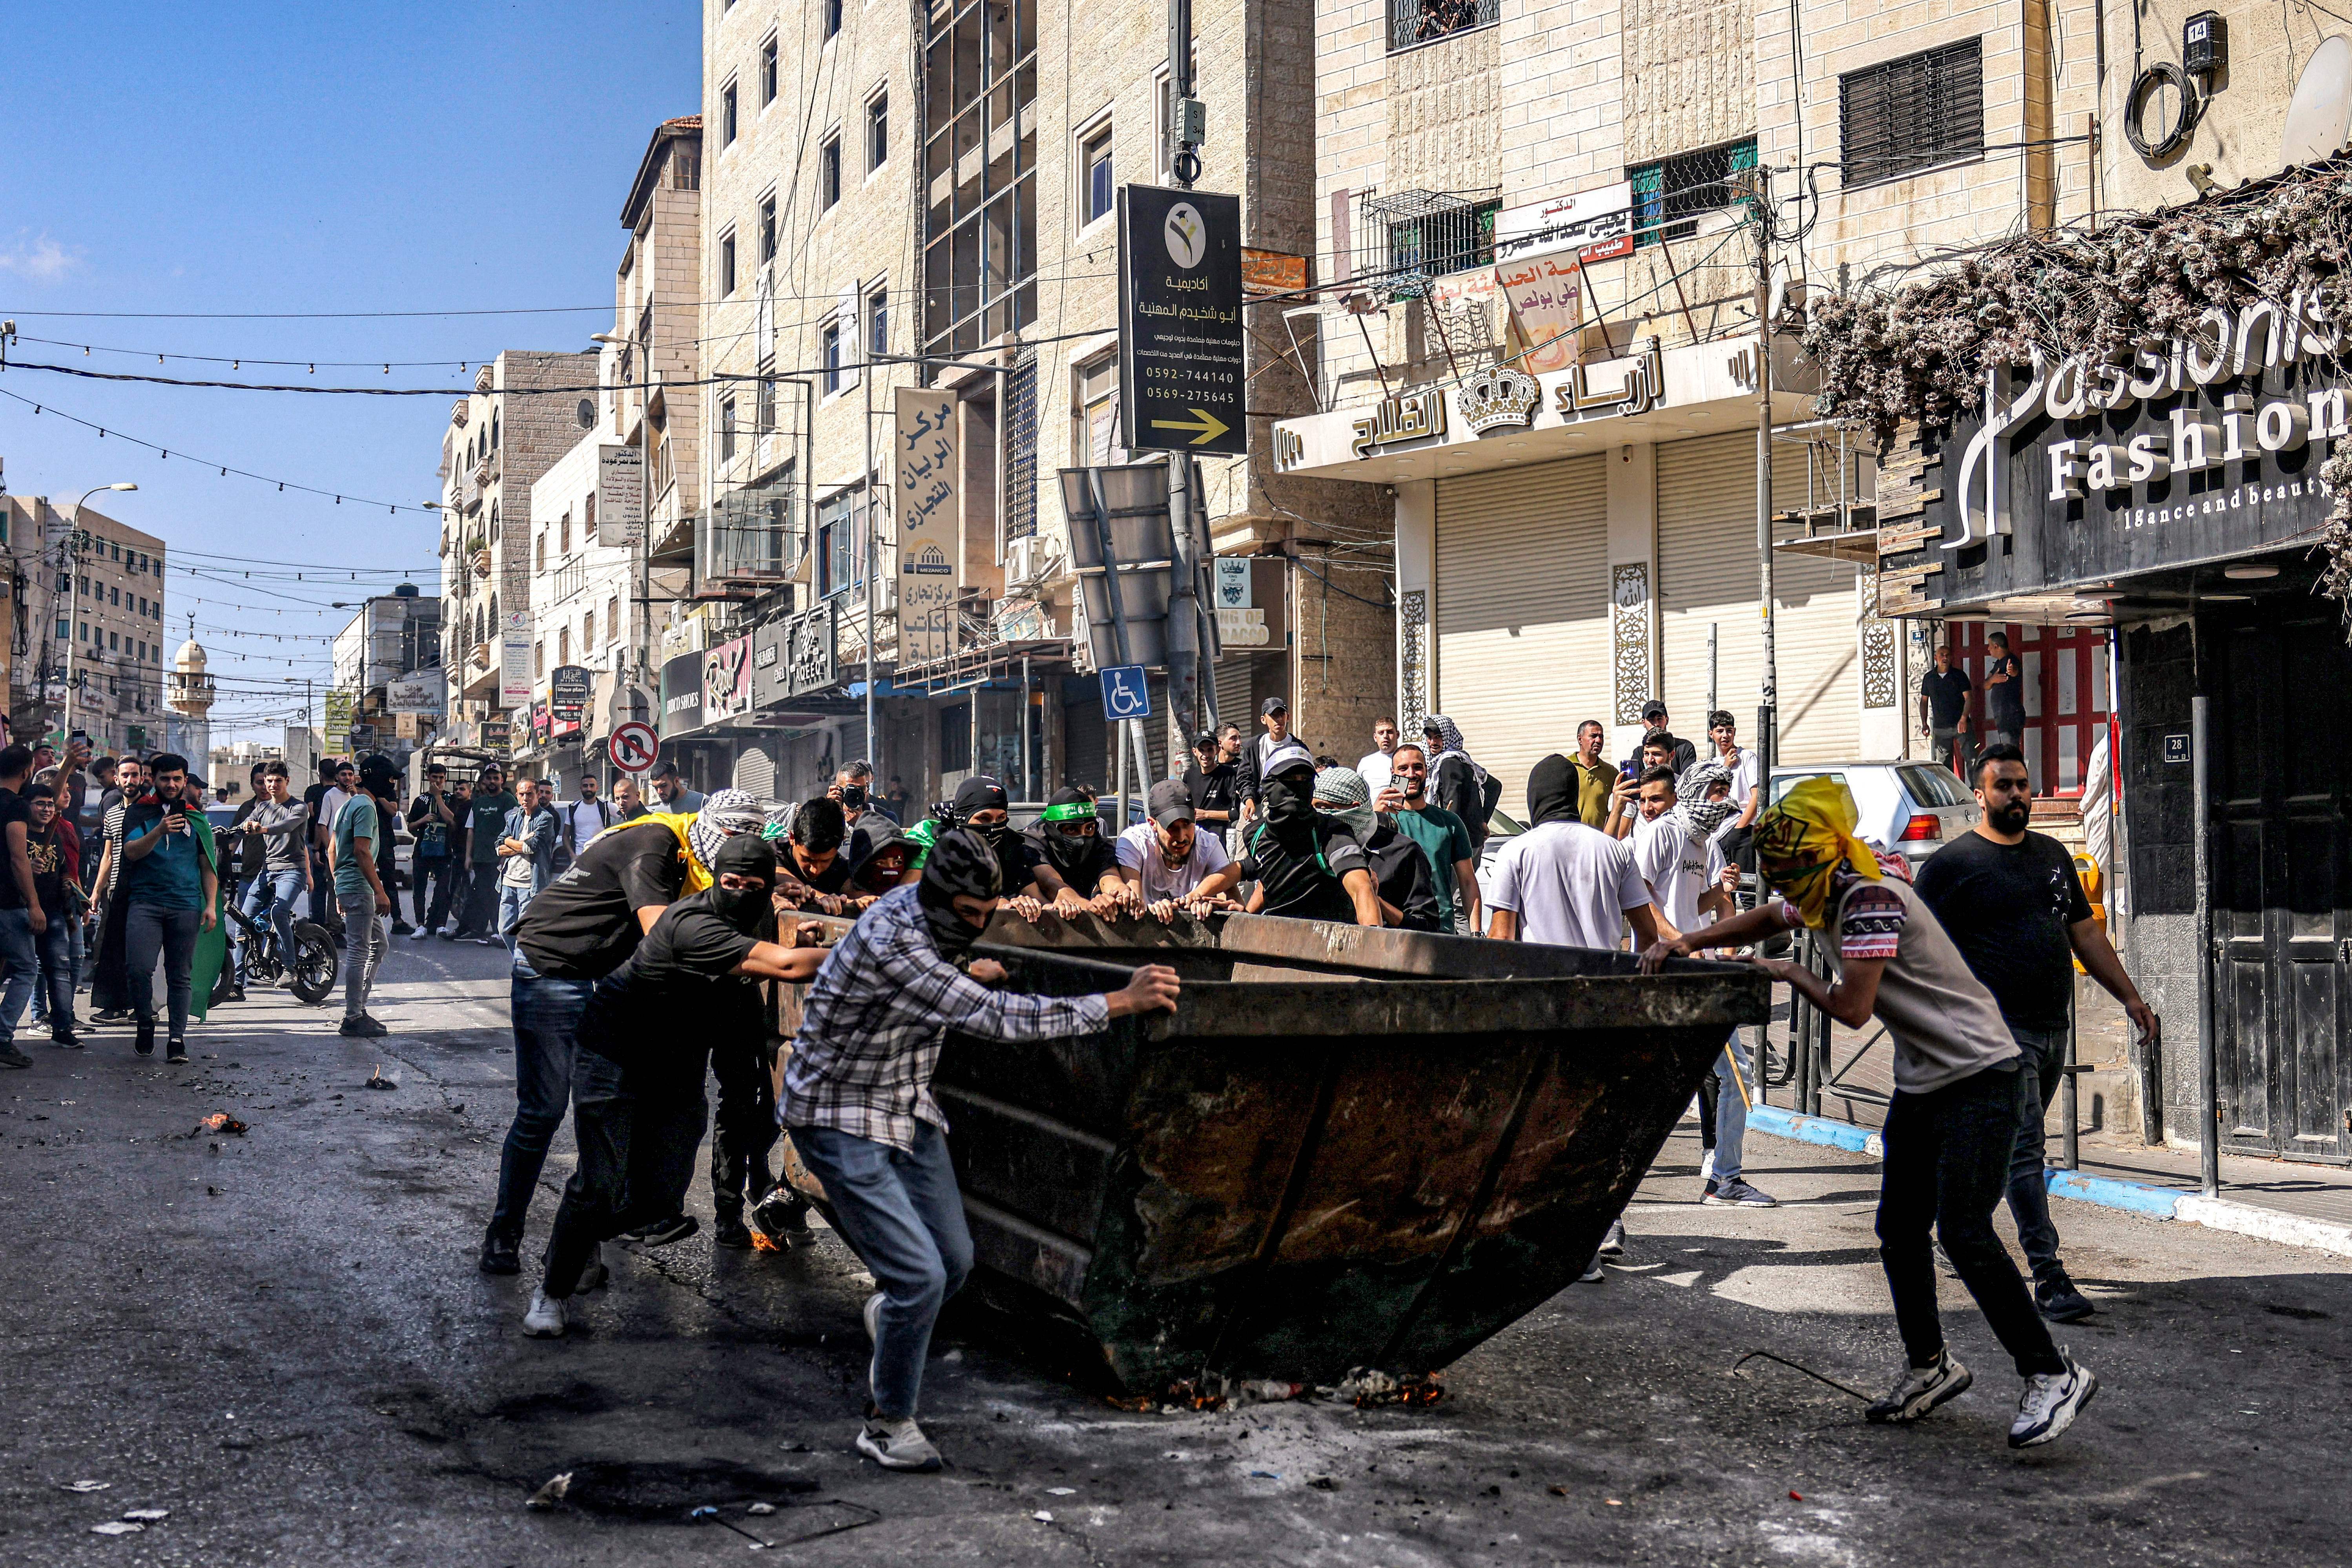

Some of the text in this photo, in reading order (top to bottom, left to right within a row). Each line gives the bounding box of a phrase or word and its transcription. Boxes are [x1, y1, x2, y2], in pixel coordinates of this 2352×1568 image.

[2190, 24, 2204, 40] 14
[1540, 197, 1576, 218] الدكتور
[1595, 239, 1624, 256] طبيب
[1166, 276, 1208, 292] أكاديمية
[1139, 302, 1236, 324] أبو شخيدم المهنية
[1154, 334, 1173, 342] توجيهي
[1221, 339, 1240, 347] دبلومات
[1227, 356, 1242, 364] دورات
[1147, 367, 1233, 383] 0592-744140
[1147, 387, 1234, 403] 0569-275645
[900, 403, 952, 450] مركز
[1352, 389, 1446, 460] الفلاح
[2048, 388, 2348, 501] Fashion
[602, 457, 617, 465] عودة
[902, 437, 953, 490] الريان
[2202, 489, 2240, 514] and
[2249, 477, 2334, 505] beauty
[905, 584, 952, 606] مركز تجاري
[904, 613, 952, 638] مكاتب
[1245, 611, 1263, 624] OF
[757, 646, 776, 667] NUMBER
[904, 640, 952, 665] فندق
[796, 661, 824, 682] AQEEQ
[680, 691, 699, 710] SHOES
[2171, 739, 2182, 750] 28
[231, 904, 244, 917] STARK
